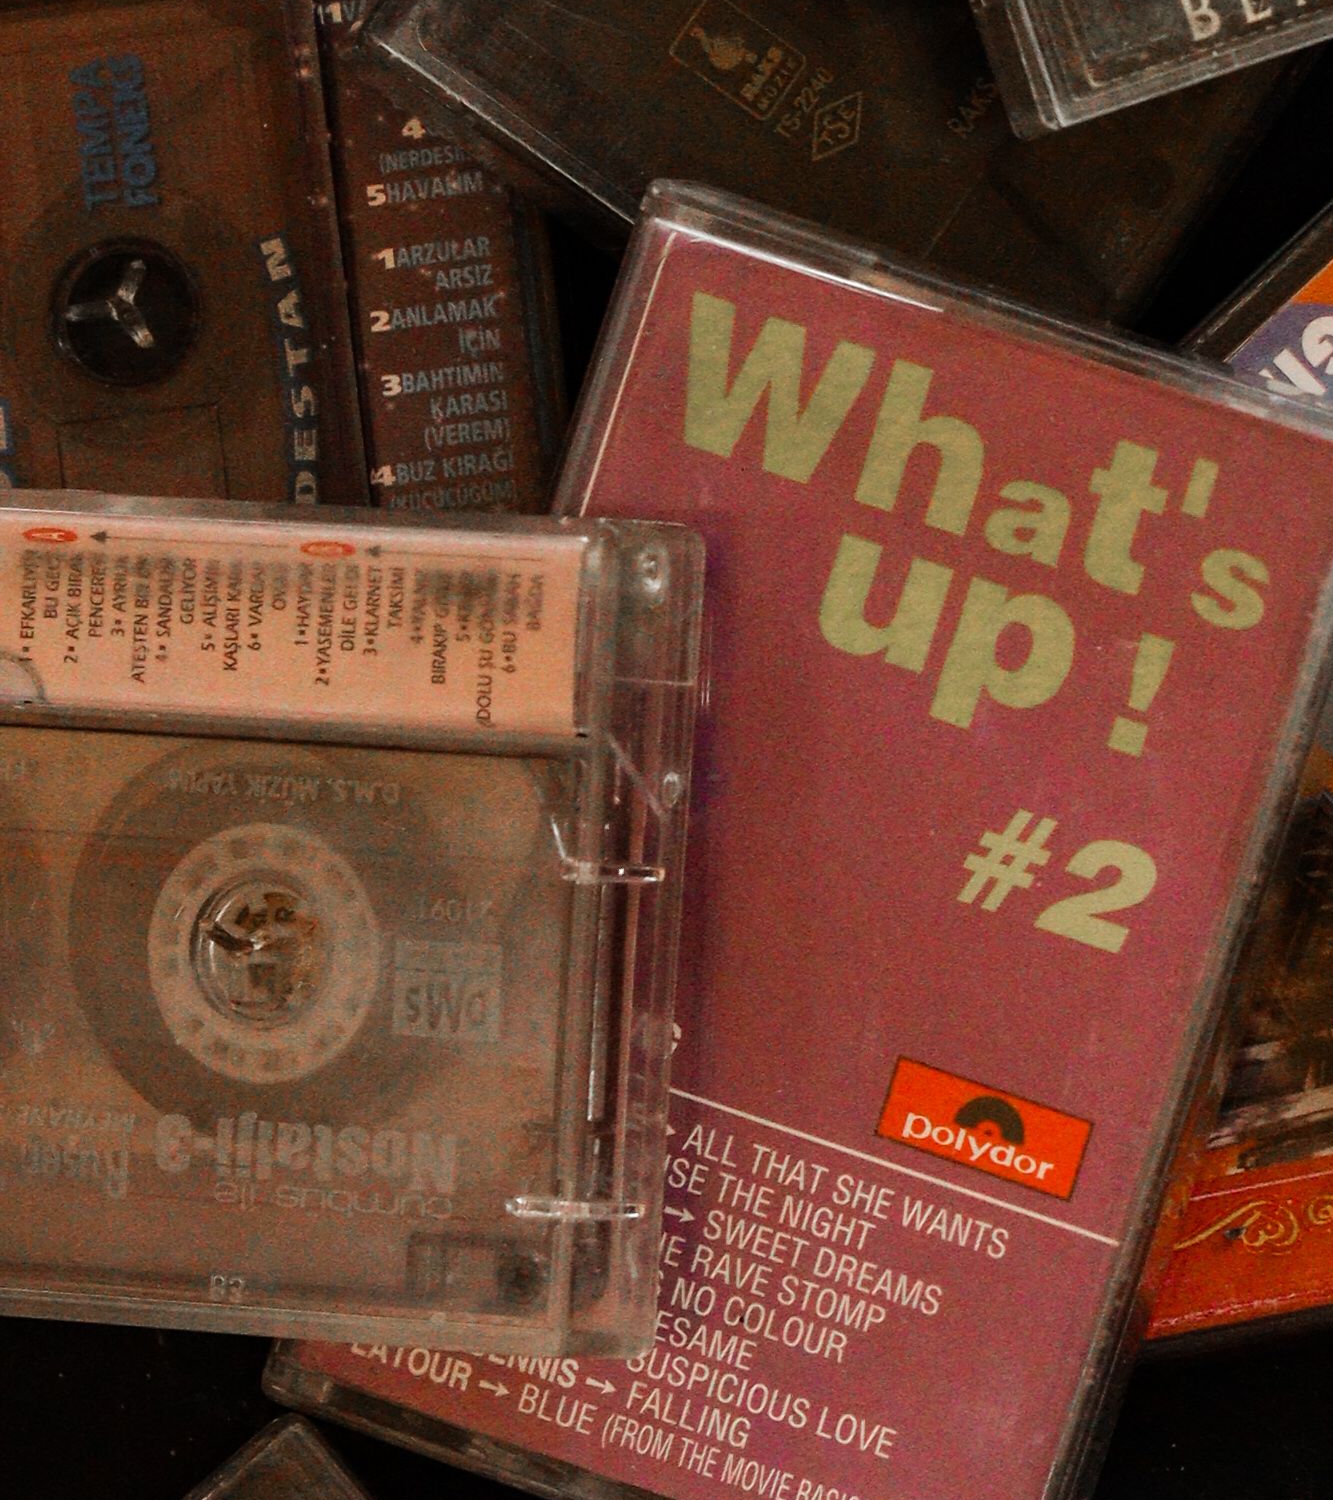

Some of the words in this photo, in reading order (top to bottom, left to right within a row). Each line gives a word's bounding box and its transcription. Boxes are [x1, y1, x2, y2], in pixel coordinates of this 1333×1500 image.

[388, 296, 498, 330] ANLAMAK
[681, 290, 1272, 631] What's
[956, 810, 1159, 954] #2
[898, 1111, 1058, 1182] polydor
[745, 1143, 831, 1197] THAT
[895, 1196, 1013, 1261] WANTS
[777, 1194, 878, 1253] NIGHT
[688, 1243, 774, 1298] RAVE
[774, 1272, 890, 1337] STOMP
[698, 1208, 812, 1270] SWEET
[808, 1246, 947, 1319] DREAMS
